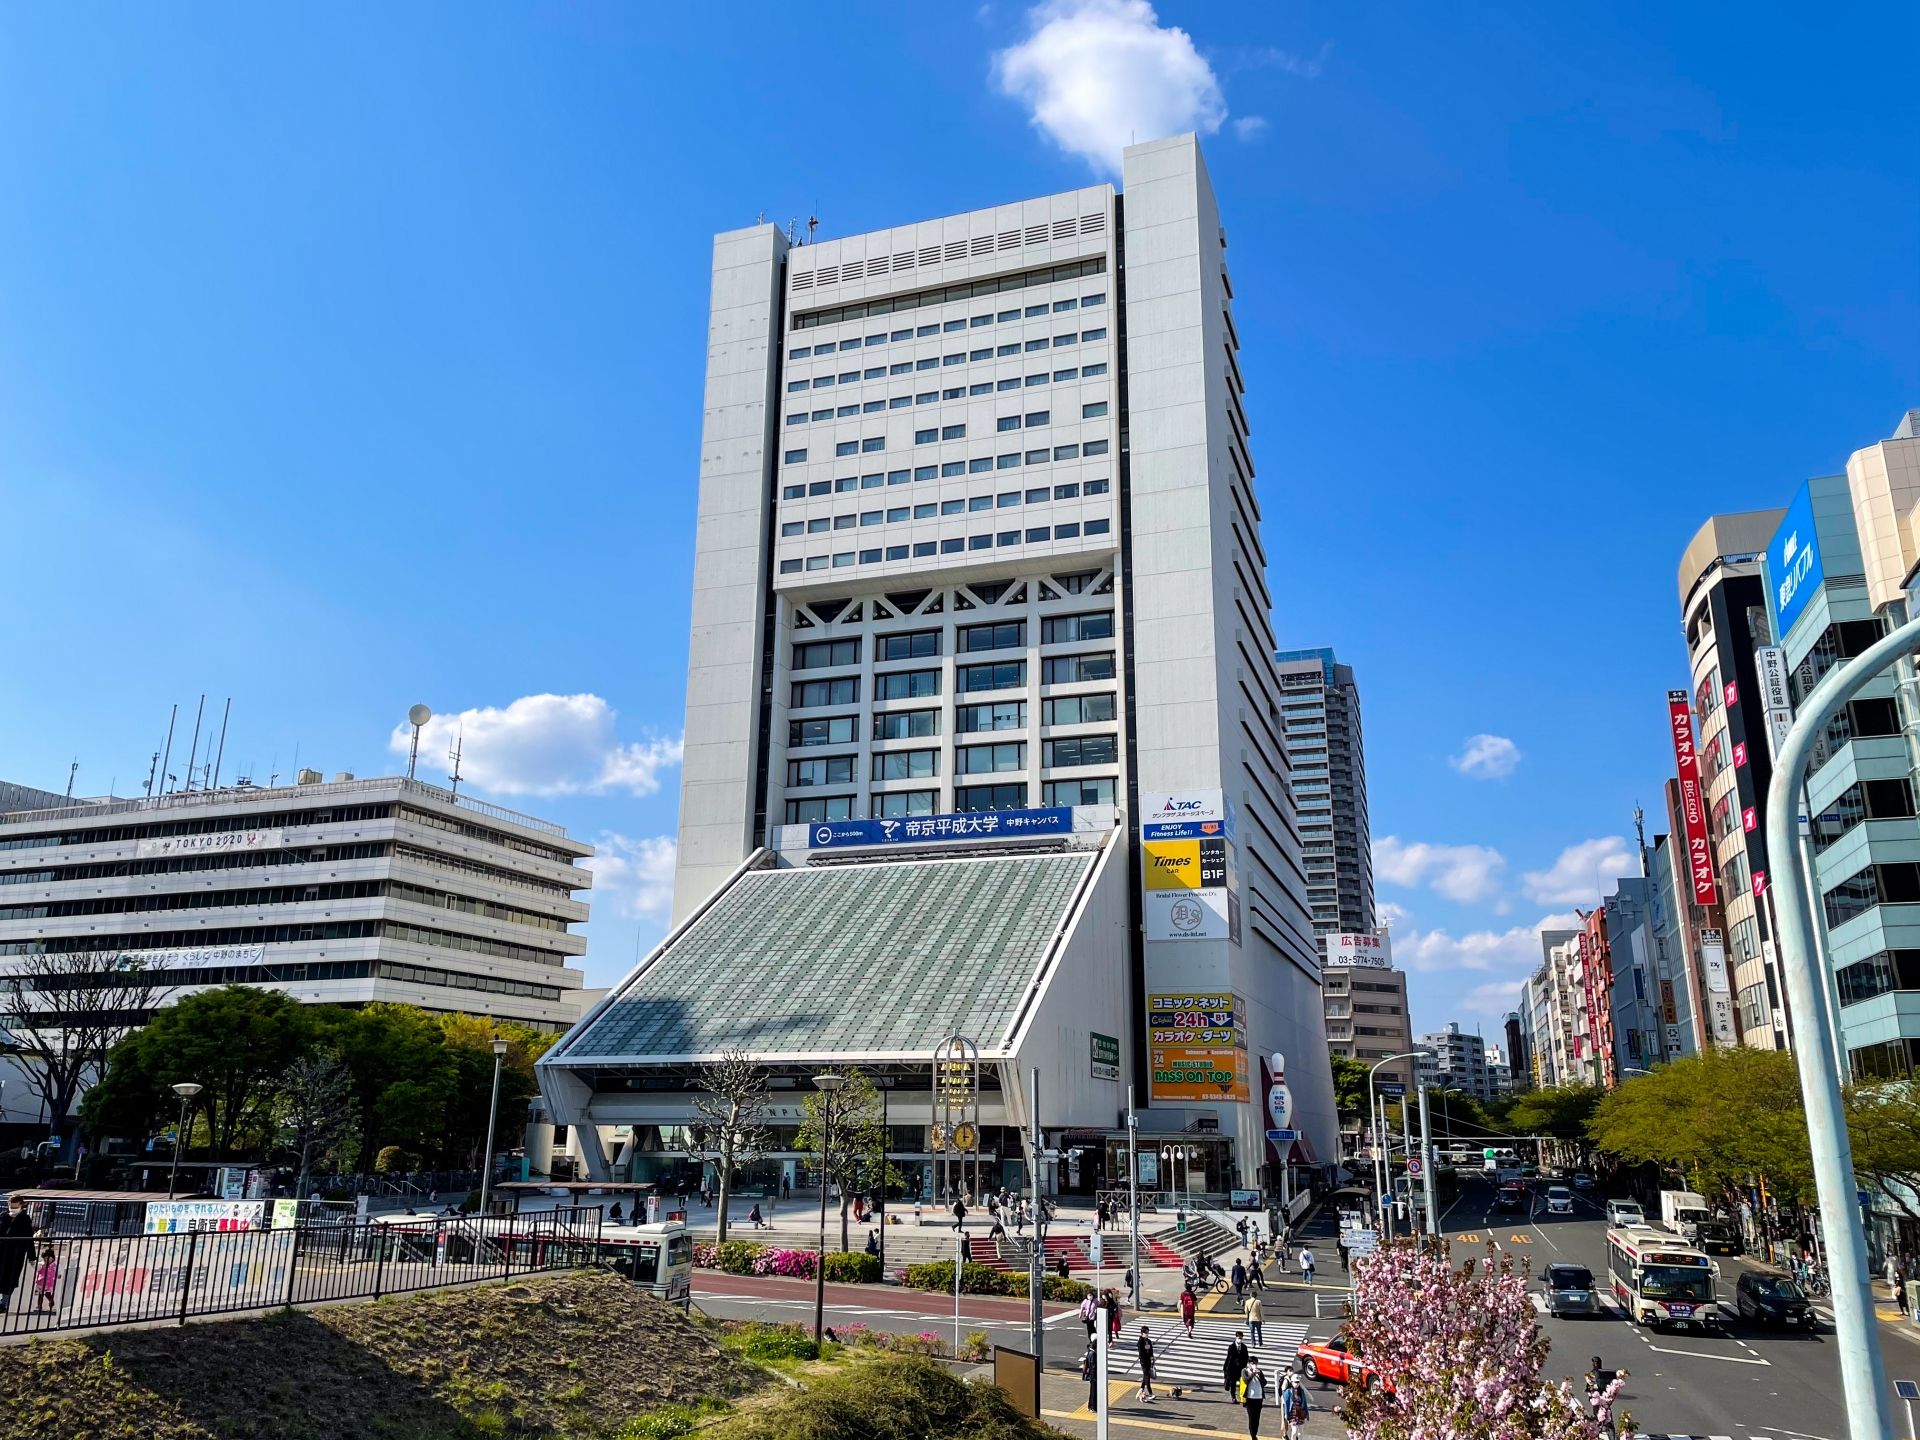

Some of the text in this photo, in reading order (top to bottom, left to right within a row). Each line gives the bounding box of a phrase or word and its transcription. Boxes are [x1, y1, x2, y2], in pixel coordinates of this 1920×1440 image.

[1779, 541, 1814, 614] 東急リバブル
[1765, 651, 1784, 706] 中野公証役場
[1674, 713, 1695, 767] カラオケ
[1683, 780, 1695, 798] BIG
[1176, 800, 1202, 810] TAC
[1688, 798, 1699, 824] ECHO
[905, 815, 1059, 837] 帝京平成大学 中野キャンパス
[176, 834, 242, 849] TOKYO 2020
[1153, 856, 1192, 867] Times
[1691, 837, 1712, 894] カラオケ
[1202, 869, 1225, 880] B1F
[1341, 935, 1381, 949] 広告募集
[182, 951, 210, 961] くらしに
[213, 949, 257, 959] 中野のまちに
[1153, 997, 1229, 1009] コミック・ネット
[1174, 1011, 1209, 1028] 24h
[1153, 1031, 1231, 1043] カラオケ・ダーツ
[1153, 1054, 1164, 1064] 24
[1172, 1060, 1191, 1068] MUSIC
[1154, 1069, 1233, 1083] BASS ON TOP
[1456, 1234, 1480, 1243] 40
[1510, 1234, 1534, 1244] 40
